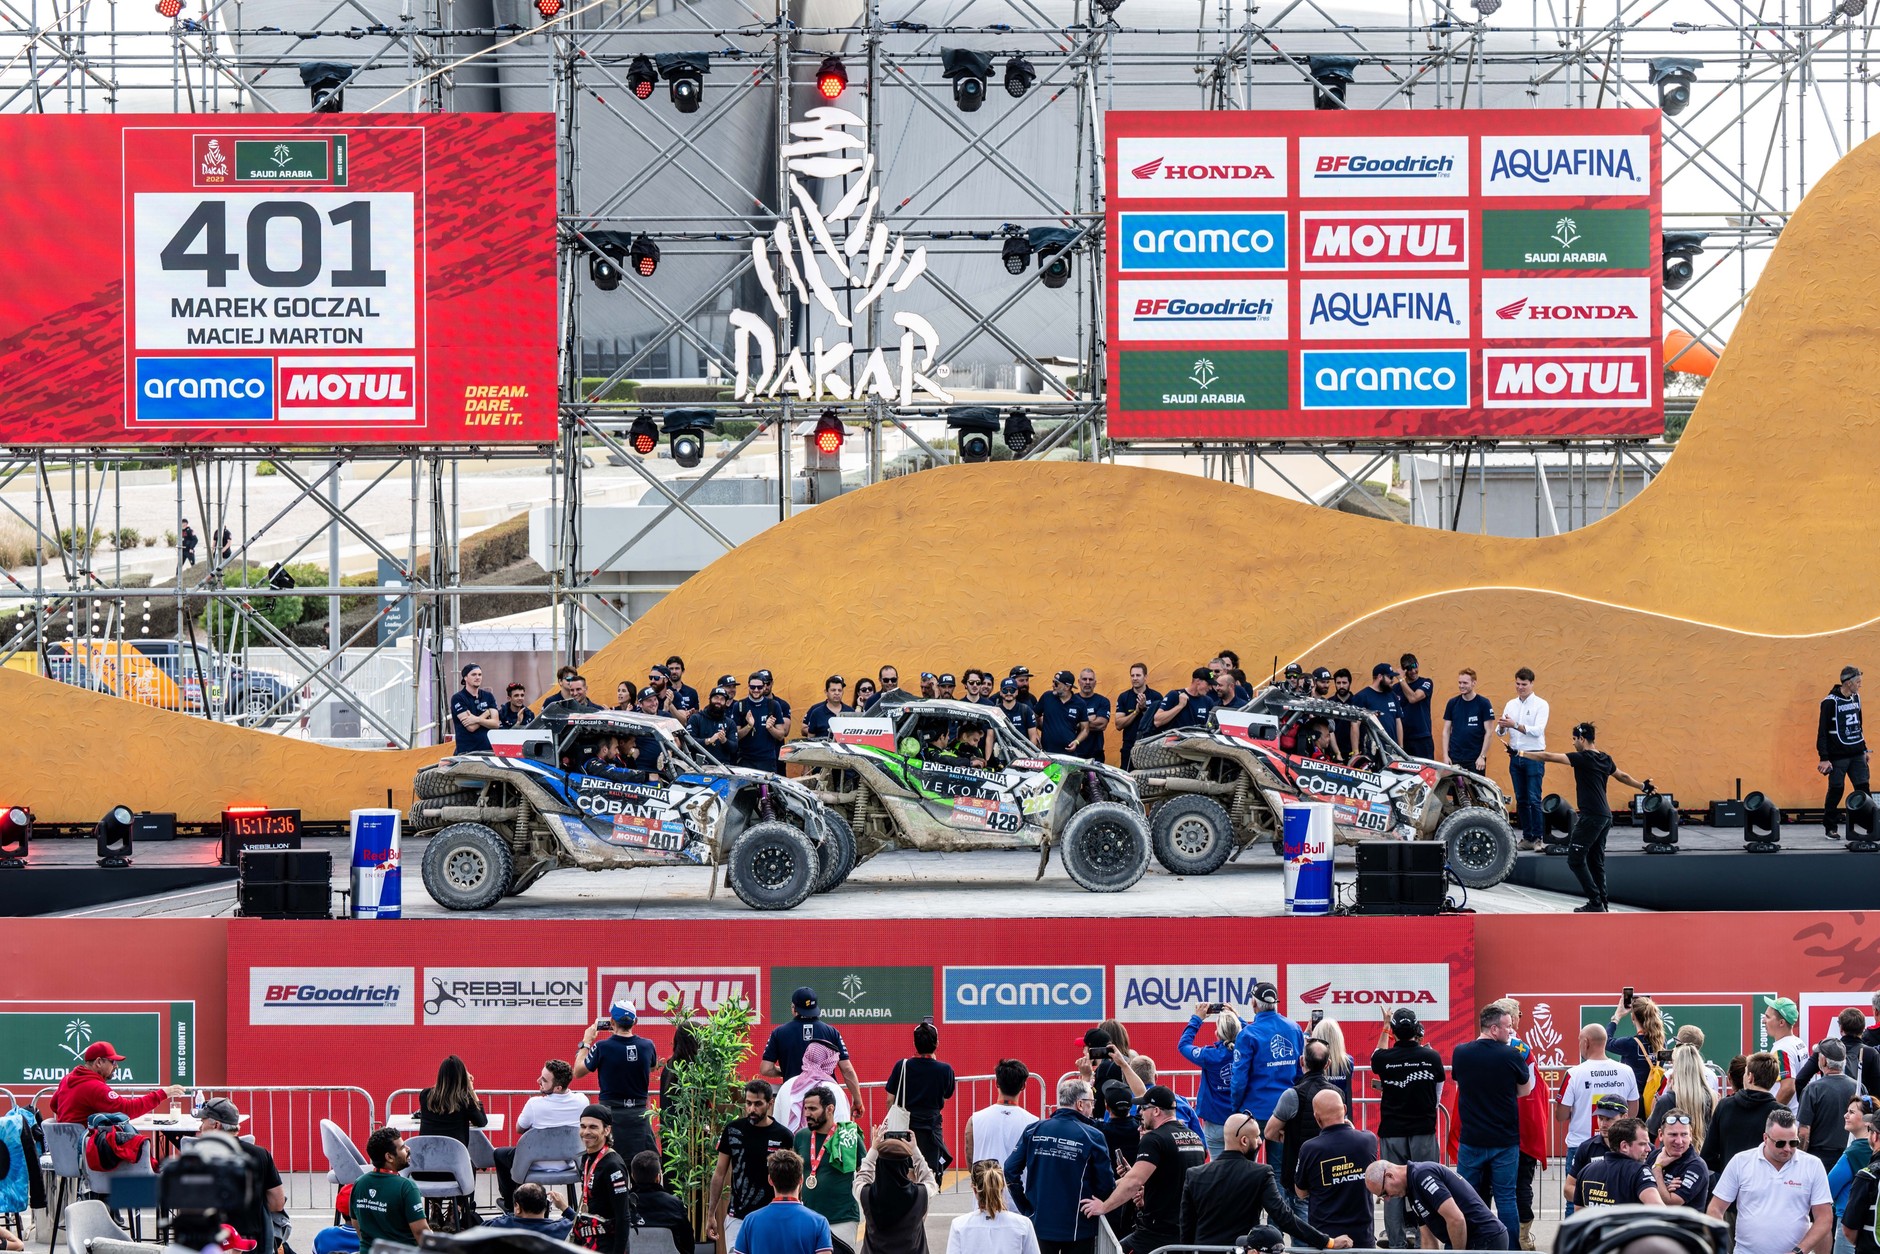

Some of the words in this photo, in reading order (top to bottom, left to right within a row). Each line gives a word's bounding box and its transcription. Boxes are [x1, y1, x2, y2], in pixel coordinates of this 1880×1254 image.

[201, 163, 229, 176] DAKAR
[1165, 165, 1275, 180] HONDA
[1315, 155, 1453, 173] BFGoodrich
[1490, 148, 1635, 184] AQUAFINA
[250, 170, 277, 178] SAUDI
[279, 170, 313, 178] ARABIA
[159, 200, 387, 288] 401
[1133, 228, 1274, 253] aramco
[1311, 224, 1458, 257] MOTUL
[1524, 253, 1560, 263] SAUDI
[1562, 253, 1608, 263] ARABIA
[171, 297, 268, 319] MAREK
[273, 296, 380, 318] GOCZAL
[1134, 299, 1273, 316] BFGoodrich
[1310, 292, 1455, 327] AQUAFINA
[1528, 305, 1639, 320] HONDA
[187, 327, 265, 345] MACIEJ
[269, 327, 363, 344] MARTON
[729, 308, 955, 407] DAKAR
[287, 373, 407, 401] MOTUL
[1315, 366, 1457, 392] aramco
[1494, 361, 1641, 395] MOTUL
[144, 377, 265, 399] aramco
[464, 385, 529, 399] DREAM.
[464, 399, 513, 412] DARE.
[1162, 393, 1198, 404] SAUDI
[1200, 393, 1246, 404] ARABIA
[464, 412, 500, 426] LIVE
[503, 412, 524, 426] IT.
[1845, 713, 1859, 726] 21
[842, 728, 884, 736] can-am
[922, 761, 1008, 786] ENERGYLANDIA
[1301, 759, 1382, 786] ENERGYLANDIA
[581, 777, 669, 802] ENERGYLANDIA
[1295, 775, 1378, 802] COBANT
[576, 794, 666, 820] COBANT
[234, 815, 295, 836] 15:17:36
[986, 811, 1018, 832] 428
[1357, 811, 1388, 831] 405
[616, 834, 644, 843] MOTUL
[649, 832, 679, 850] 401
[1284, 841, 1301, 854] Red
[1303, 842, 1325, 854] Bull
[363, 848, 386, 861] Red
[265, 985, 400, 1001] BFGoodrich
[452, 981, 583, 995] REBELLION
[608, 980, 750, 1012] MOTUL
[956, 982, 1092, 1006] aramco
[1331, 990, 1438, 1004] HONDA
[819, 1008, 846, 1018] AUDI
[848, 1008, 892, 1018] ARABIA
[178, 1021, 186, 1055] COUNTRY
[178, 1056, 186, 1077] HOST
[1590, 1069, 1618, 1078] EGIDIJUS
[1593, 1080, 1625, 1089] mediafon
[1331, 1162, 1355, 1173] FRIED
